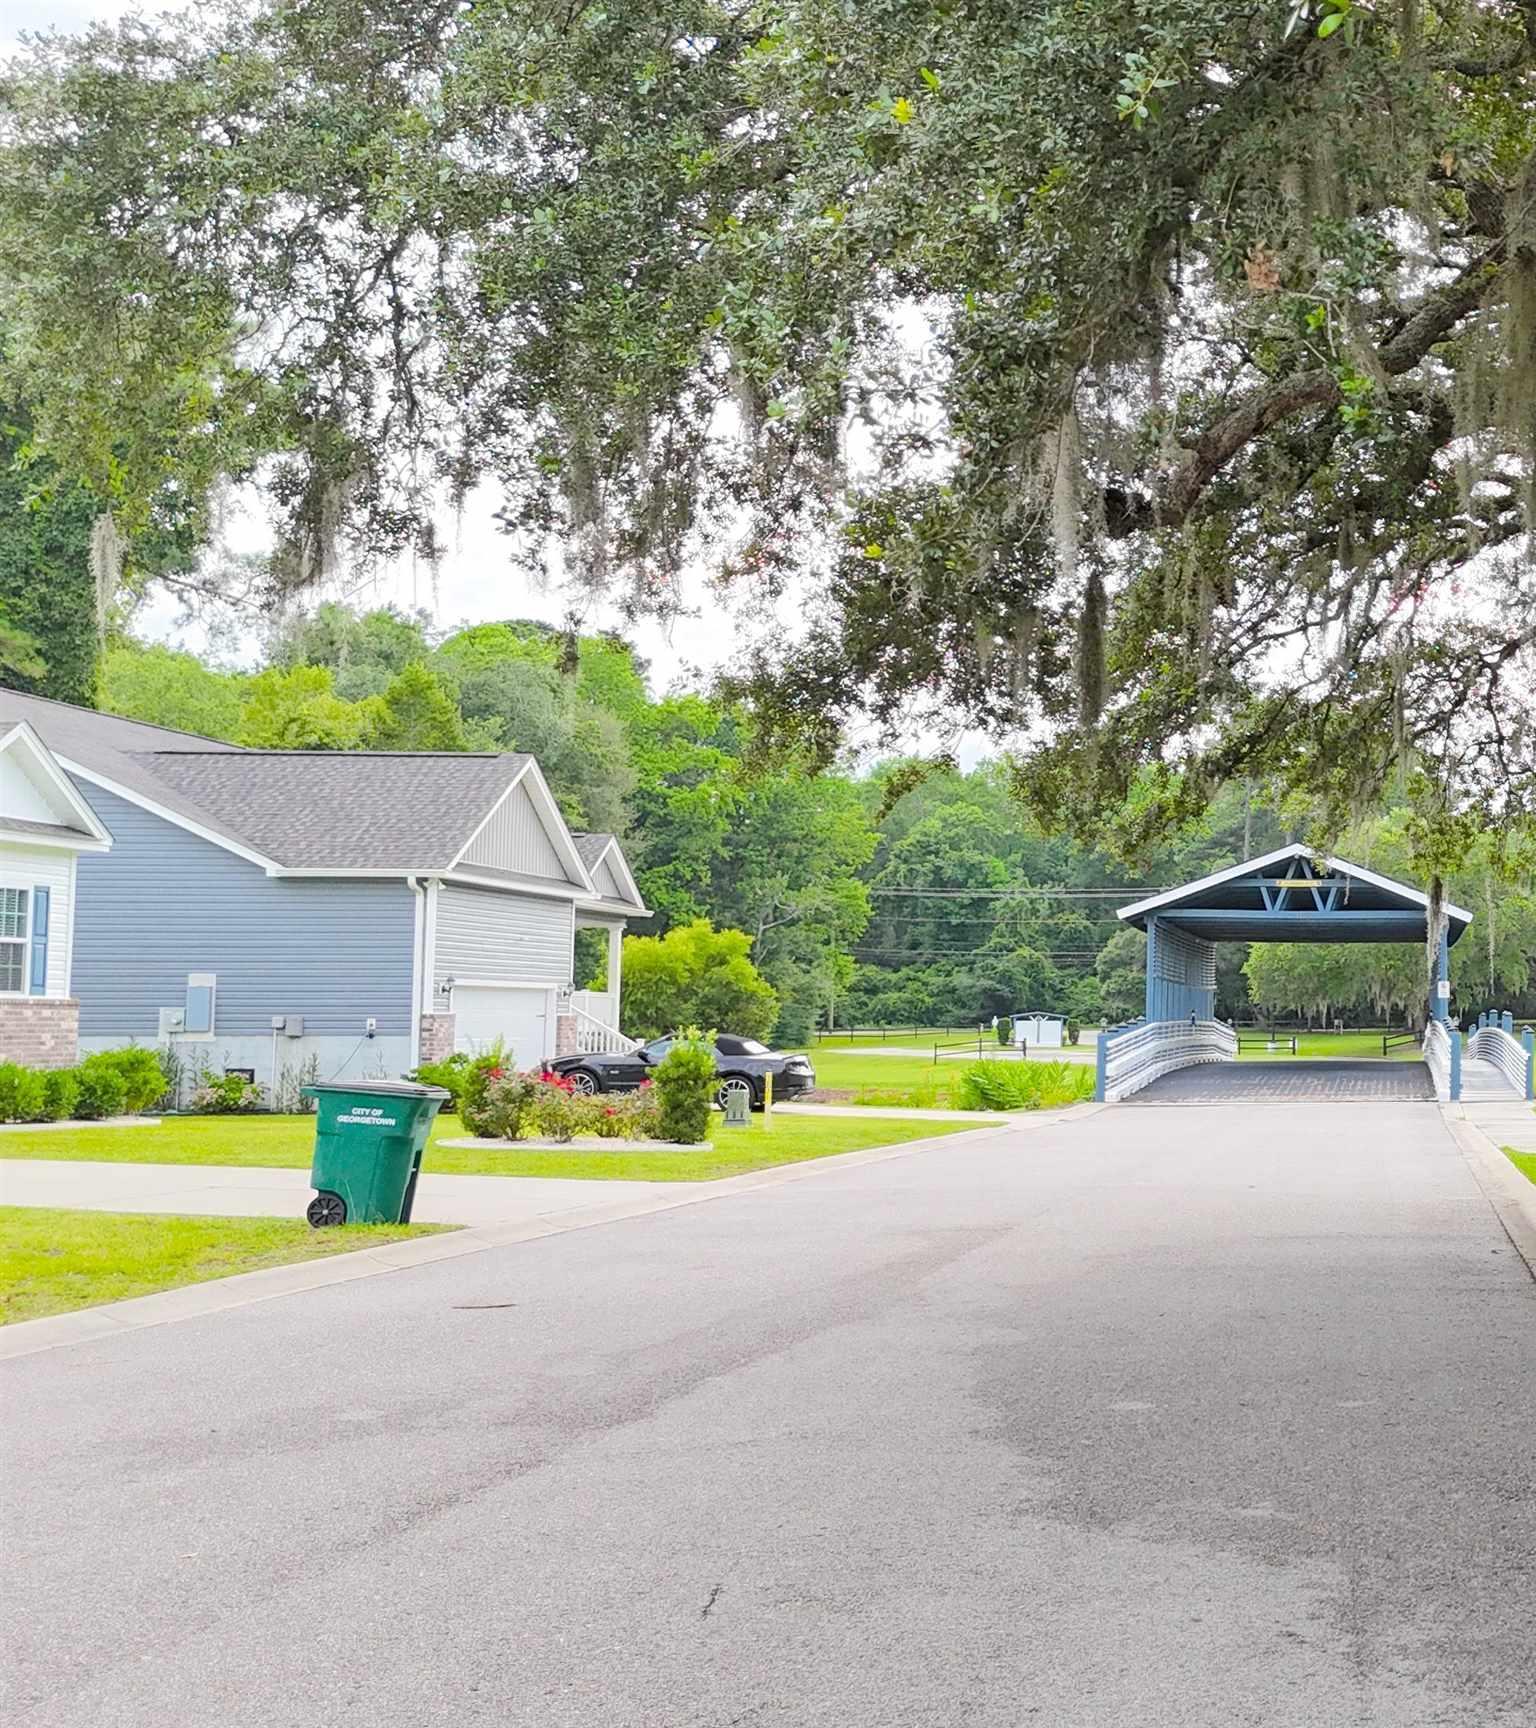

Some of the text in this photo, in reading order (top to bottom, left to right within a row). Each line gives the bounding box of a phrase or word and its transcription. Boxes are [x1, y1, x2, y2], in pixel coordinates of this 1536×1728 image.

[352, 1107, 384, 1116] CITY OF
[337, 1115, 396, 1126] GEORGETOWN
